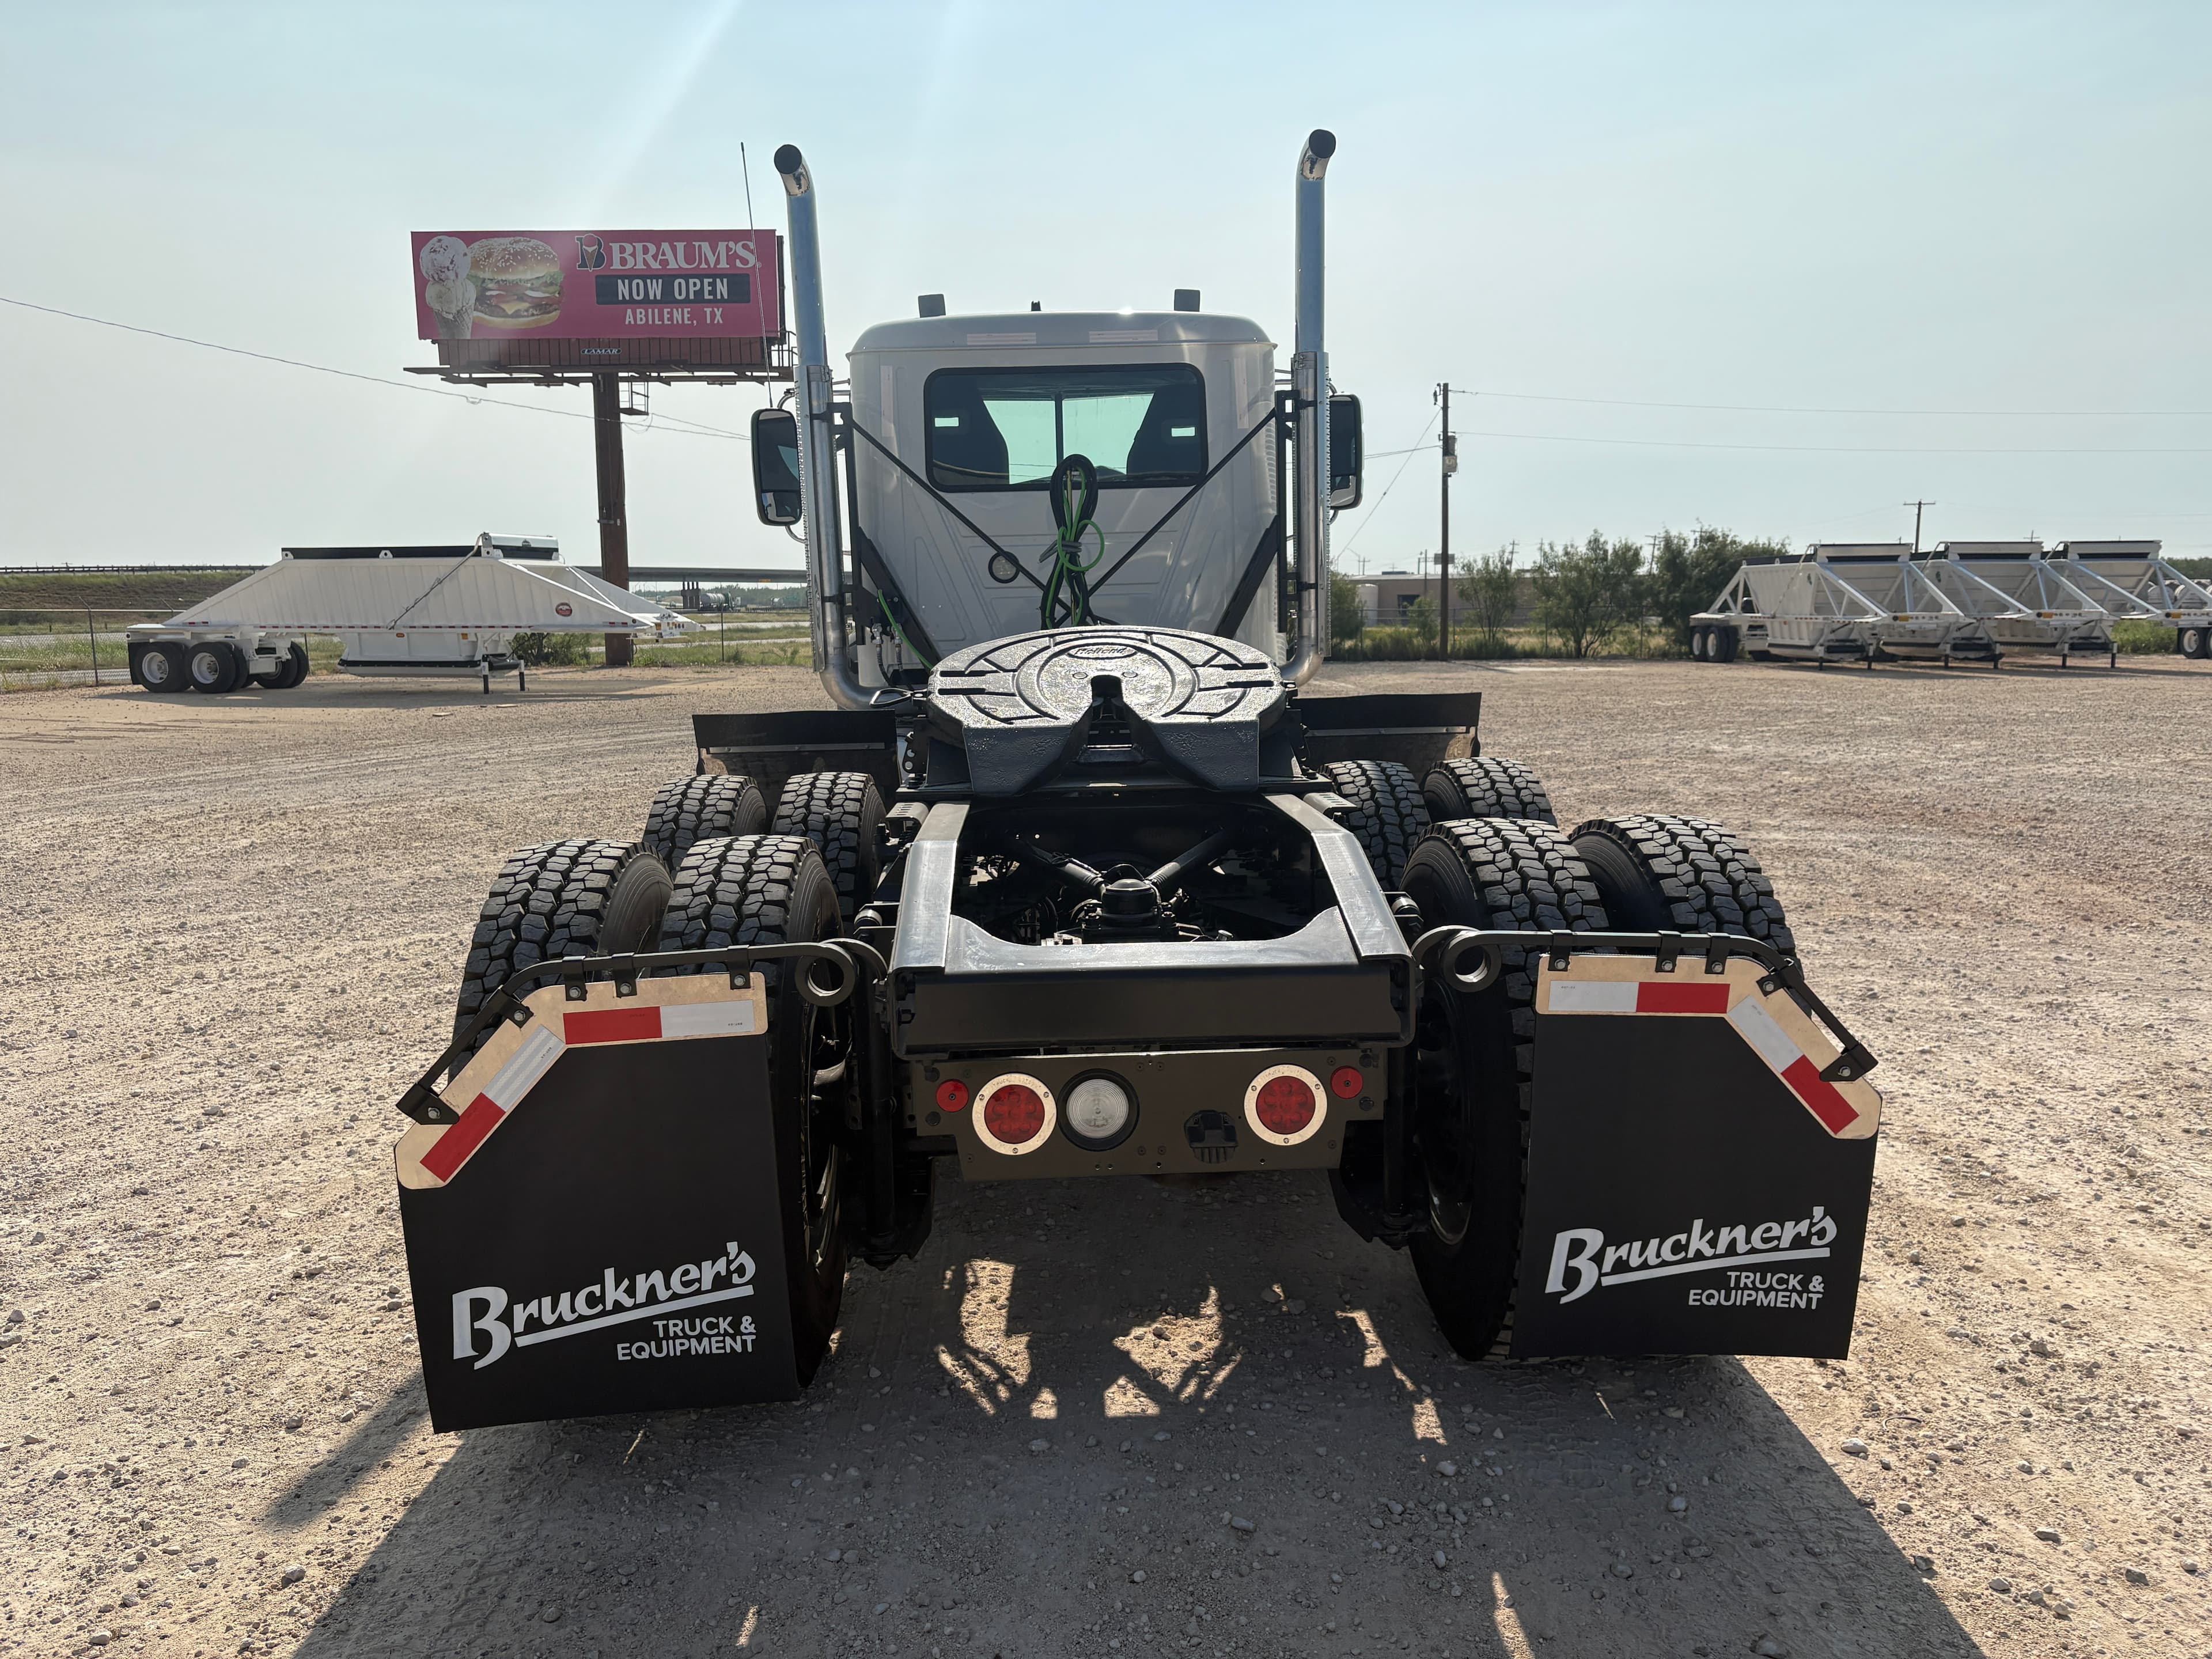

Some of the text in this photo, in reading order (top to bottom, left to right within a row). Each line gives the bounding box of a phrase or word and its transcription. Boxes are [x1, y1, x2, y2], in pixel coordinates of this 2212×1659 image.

[609, 241, 756, 270] BRAUM'S
[618, 278, 728, 300] NOW OPEN
[625, 308, 723, 326] ABILENE, TX
[1544, 1206, 1838, 1304] Bruckner's
[1727, 1271, 1825, 1292] TRUCK &
[452, 1241, 756, 1370] Bruckner's
[1688, 1289, 1823, 1310] EQUIPMENT
[653, 1315, 756, 1338] TRUCK &
[616, 1335, 756, 1360] EQUIPMENT
